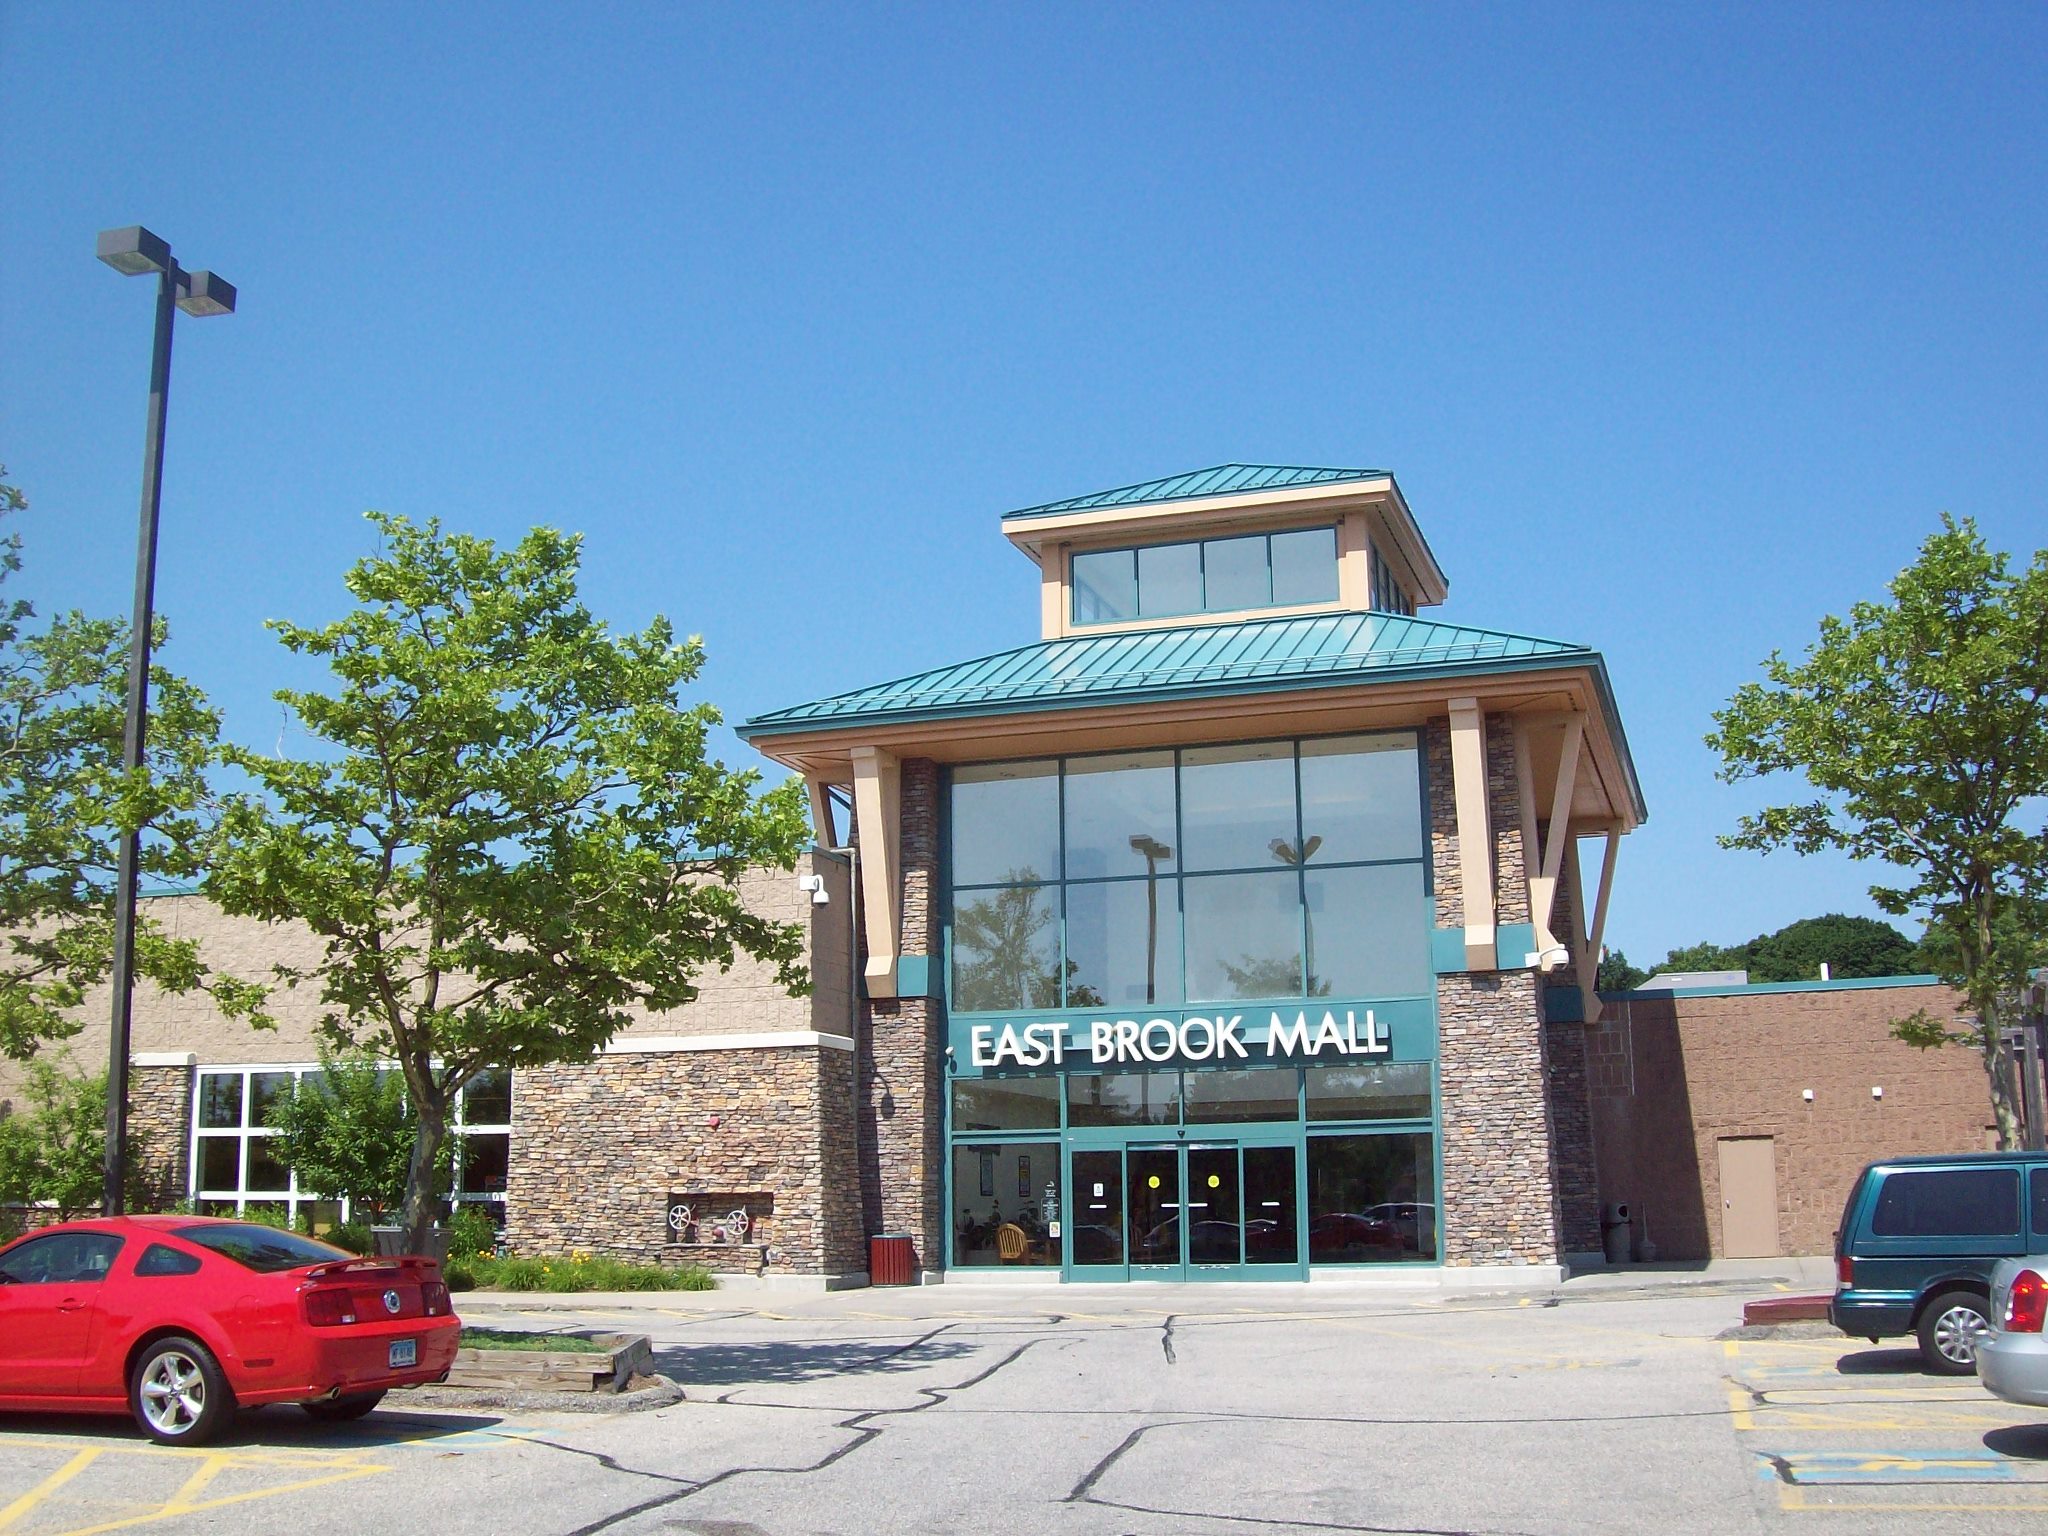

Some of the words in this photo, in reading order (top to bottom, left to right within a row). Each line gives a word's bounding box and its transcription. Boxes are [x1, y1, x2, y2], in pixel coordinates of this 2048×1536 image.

[971, 1023, 1069, 1067] EAST
[1091, 1015, 1249, 1064] BROOK
[1266, 1010, 1389, 1057] MALL
